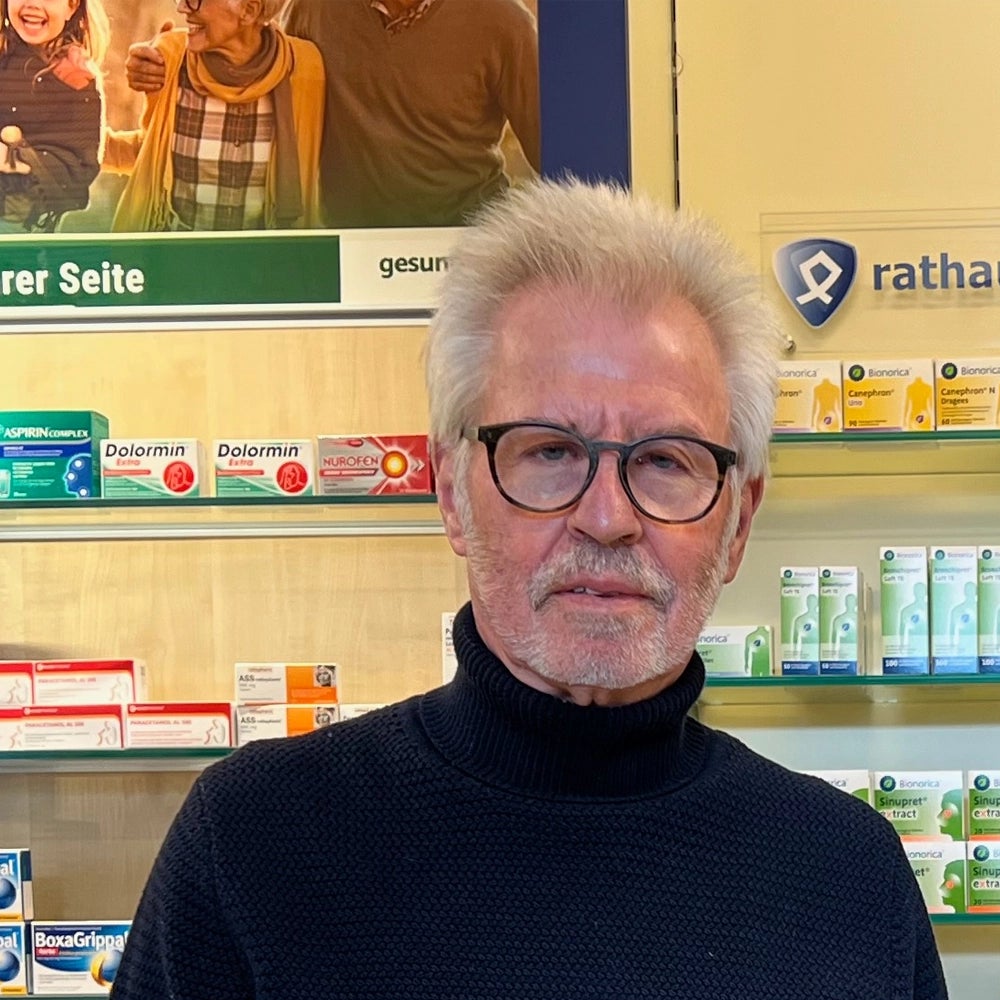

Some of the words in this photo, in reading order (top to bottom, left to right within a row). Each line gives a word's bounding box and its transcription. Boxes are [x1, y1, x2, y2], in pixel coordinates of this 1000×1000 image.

[59, 261, 145, 294] Seite
[868, 367, 910, 378] Bionorica
[3, 427, 49, 438] ASPIRIN
[105, 442, 185, 458] Dolormin
[218, 442, 299, 458] Dolormin
[323, 456, 379, 467] NUROFEN
[899, 779, 940, 788] Bionorica
[880, 809, 917, 820] extract
